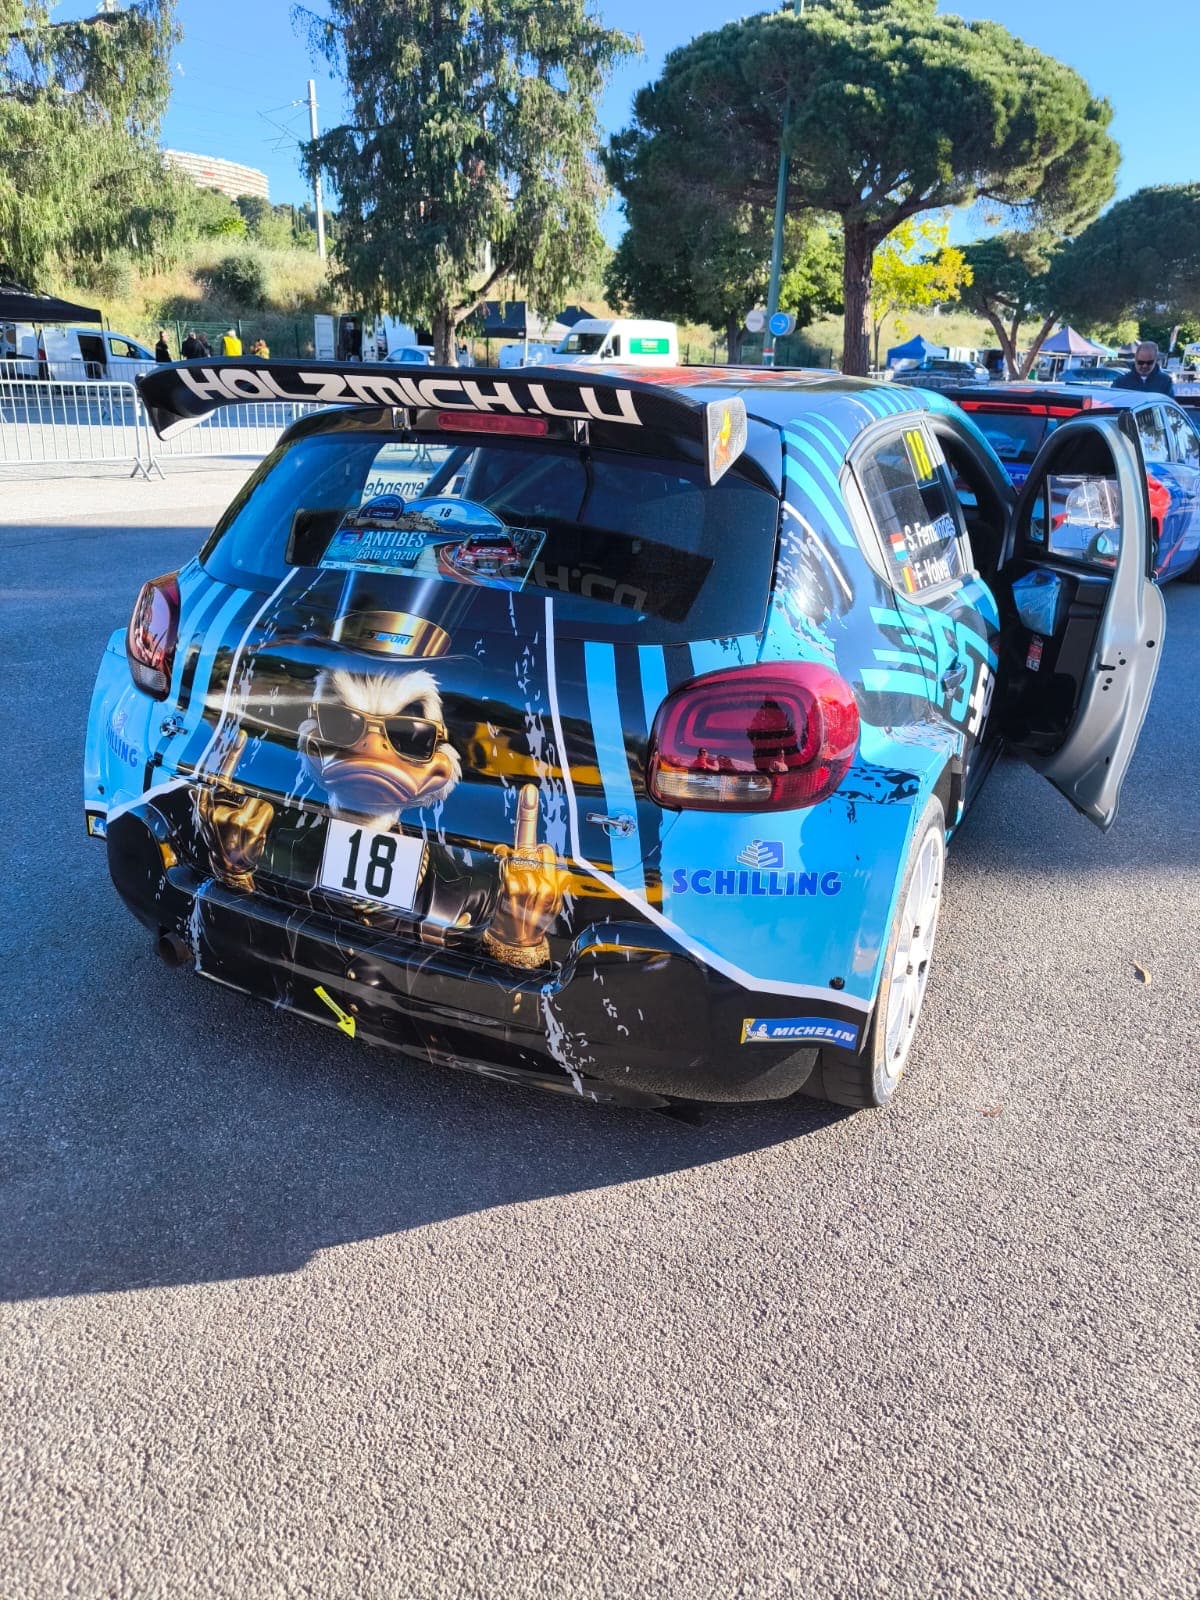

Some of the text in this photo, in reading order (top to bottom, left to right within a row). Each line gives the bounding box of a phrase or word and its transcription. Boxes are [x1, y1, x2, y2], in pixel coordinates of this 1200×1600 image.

[176, 367, 643, 427] HOLZMICH.LU
[905, 430, 933, 481] 18
[439, 507, 453, 518] 18
[362, 531, 427, 548] ANTIBES
[341, 828, 398, 899] 18
[671, 867, 843, 897] SCHILLING
[771, 1026, 856, 1043] MICHELIN
